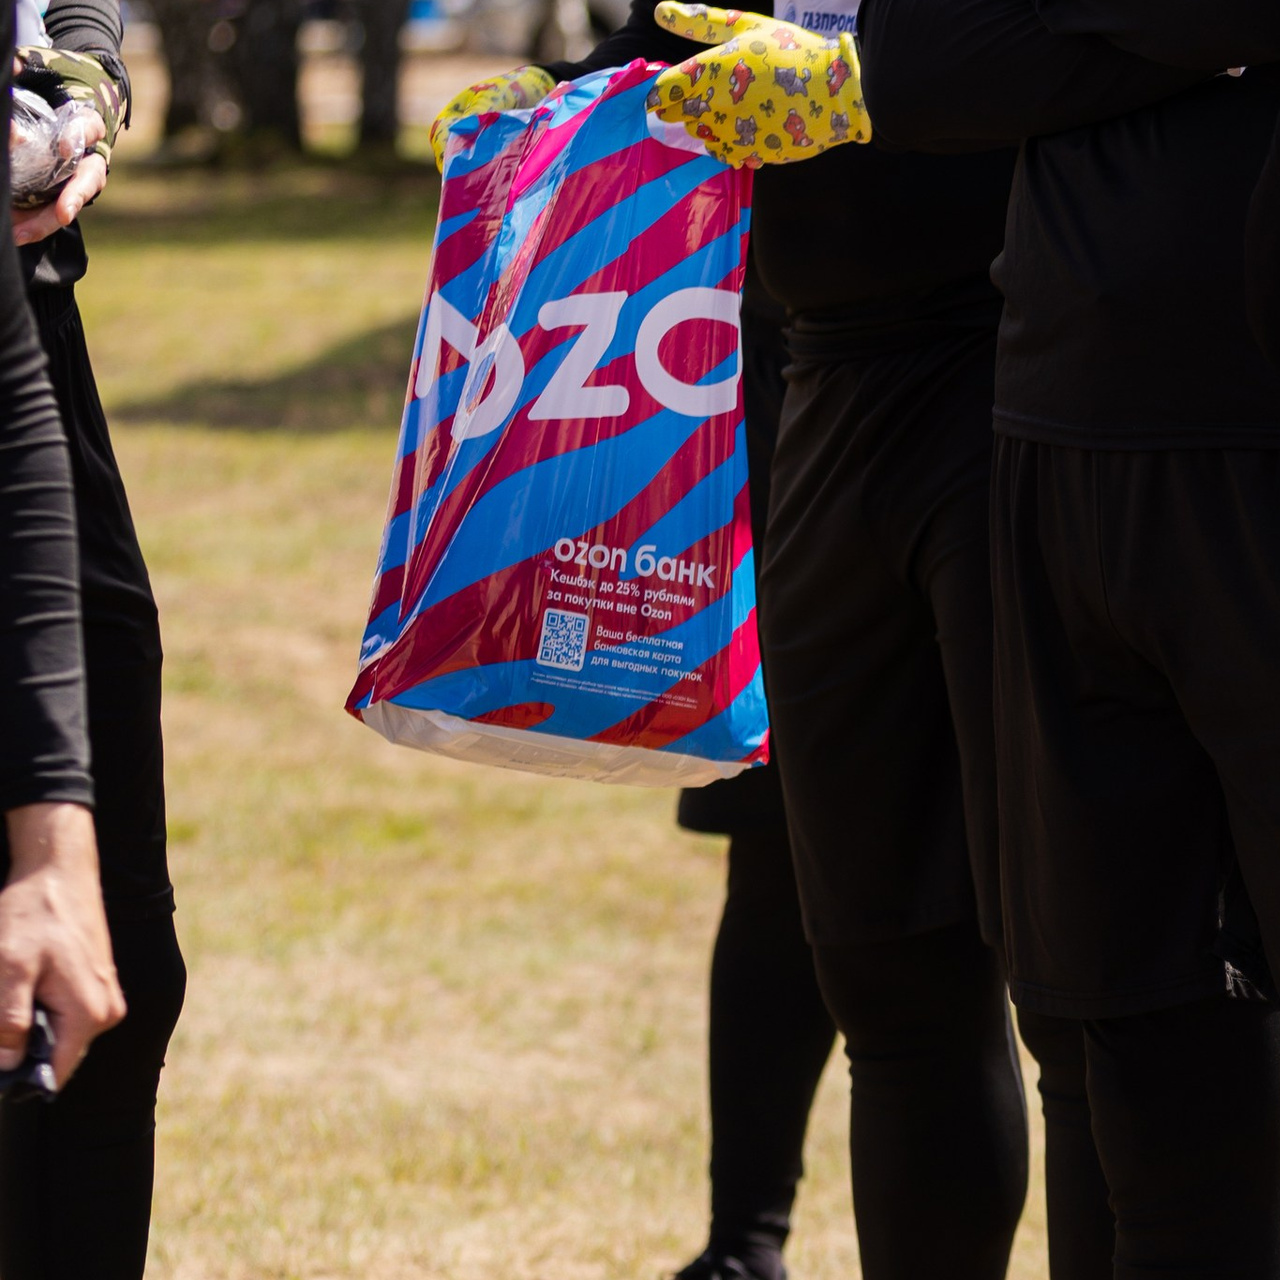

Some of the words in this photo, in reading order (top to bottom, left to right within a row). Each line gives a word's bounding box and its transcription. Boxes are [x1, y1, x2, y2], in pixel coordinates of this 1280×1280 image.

[801, 11, 858, 32] ГАЗПРОМ
[554, 537, 627, 573] ozon
[635, 544, 717, 589] банк
[550, 569, 596, 589] Кешбэк
[599, 580, 614, 594] до
[616, 581, 641, 597] 25%
[644, 588, 695, 607] рублями
[546, 590, 562, 601] за
[564, 593, 614, 611] покупки
[616, 602, 637, 615] вне
[641, 604, 672, 621] Ozon
[596, 625, 624, 641] Ваша
[625, 631, 684, 650] бесплатная
[593, 640, 650, 658] банковская
[652, 652, 682, 665] карта
[590, 656, 610, 666] для
[611, 660, 658, 675] выгодных
[661, 667, 703, 682] покупок
